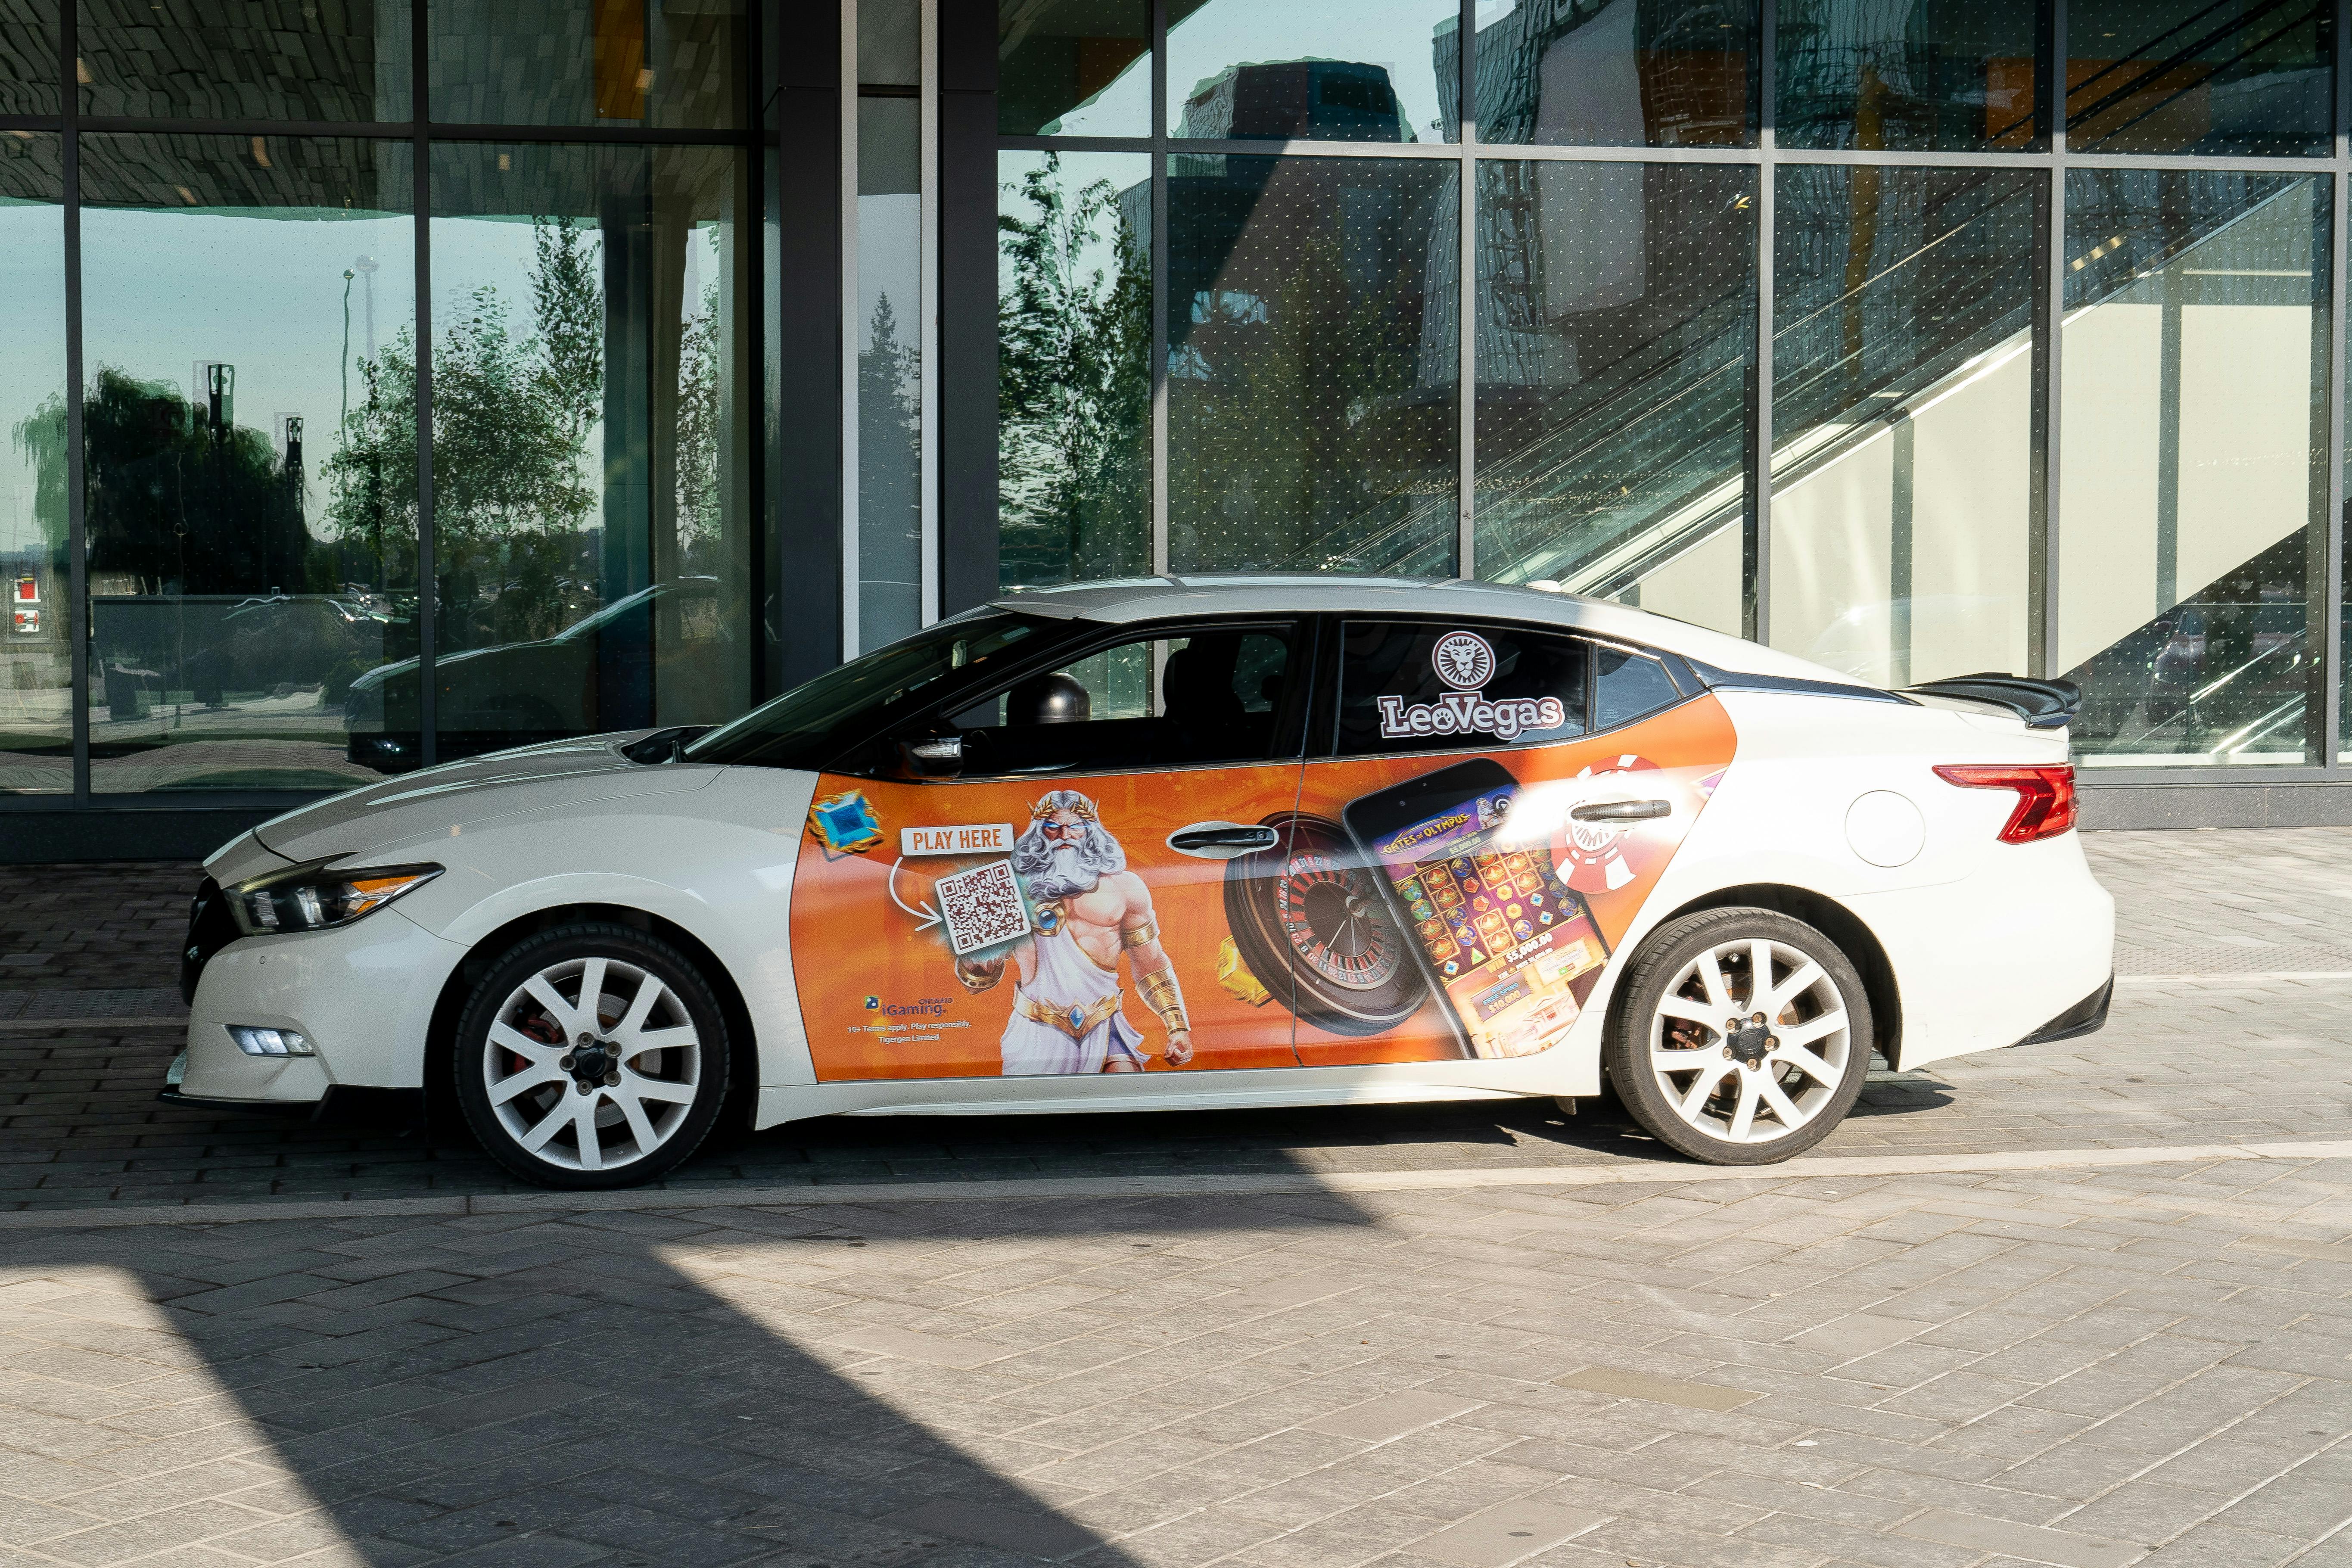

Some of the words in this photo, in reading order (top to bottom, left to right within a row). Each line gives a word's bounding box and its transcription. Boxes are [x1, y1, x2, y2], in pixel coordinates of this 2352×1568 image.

[1377, 691, 1565, 740] LeoVegas
[1383, 834, 1418, 853] GATES
[1423, 813, 1468, 838] OLYMPUS
[913, 831, 953, 850] PLAY
[959, 829, 1002, 849] HERE
[1298, 857, 1308, 868] 31
[1307, 857, 1314, 866] 9
[1314, 856, 1323, 866] 22
[1506, 933, 1553, 963] $5,000.00
[882, 1004, 943, 1017] iGaming
[887, 1024, 909, 1032] apply.
[910, 1022, 927, 1031] Play
[927, 1020, 972, 1030] responsibly.
[878, 1036, 911, 1044] Tigergen
[912, 1033, 941, 1042] Limited.
